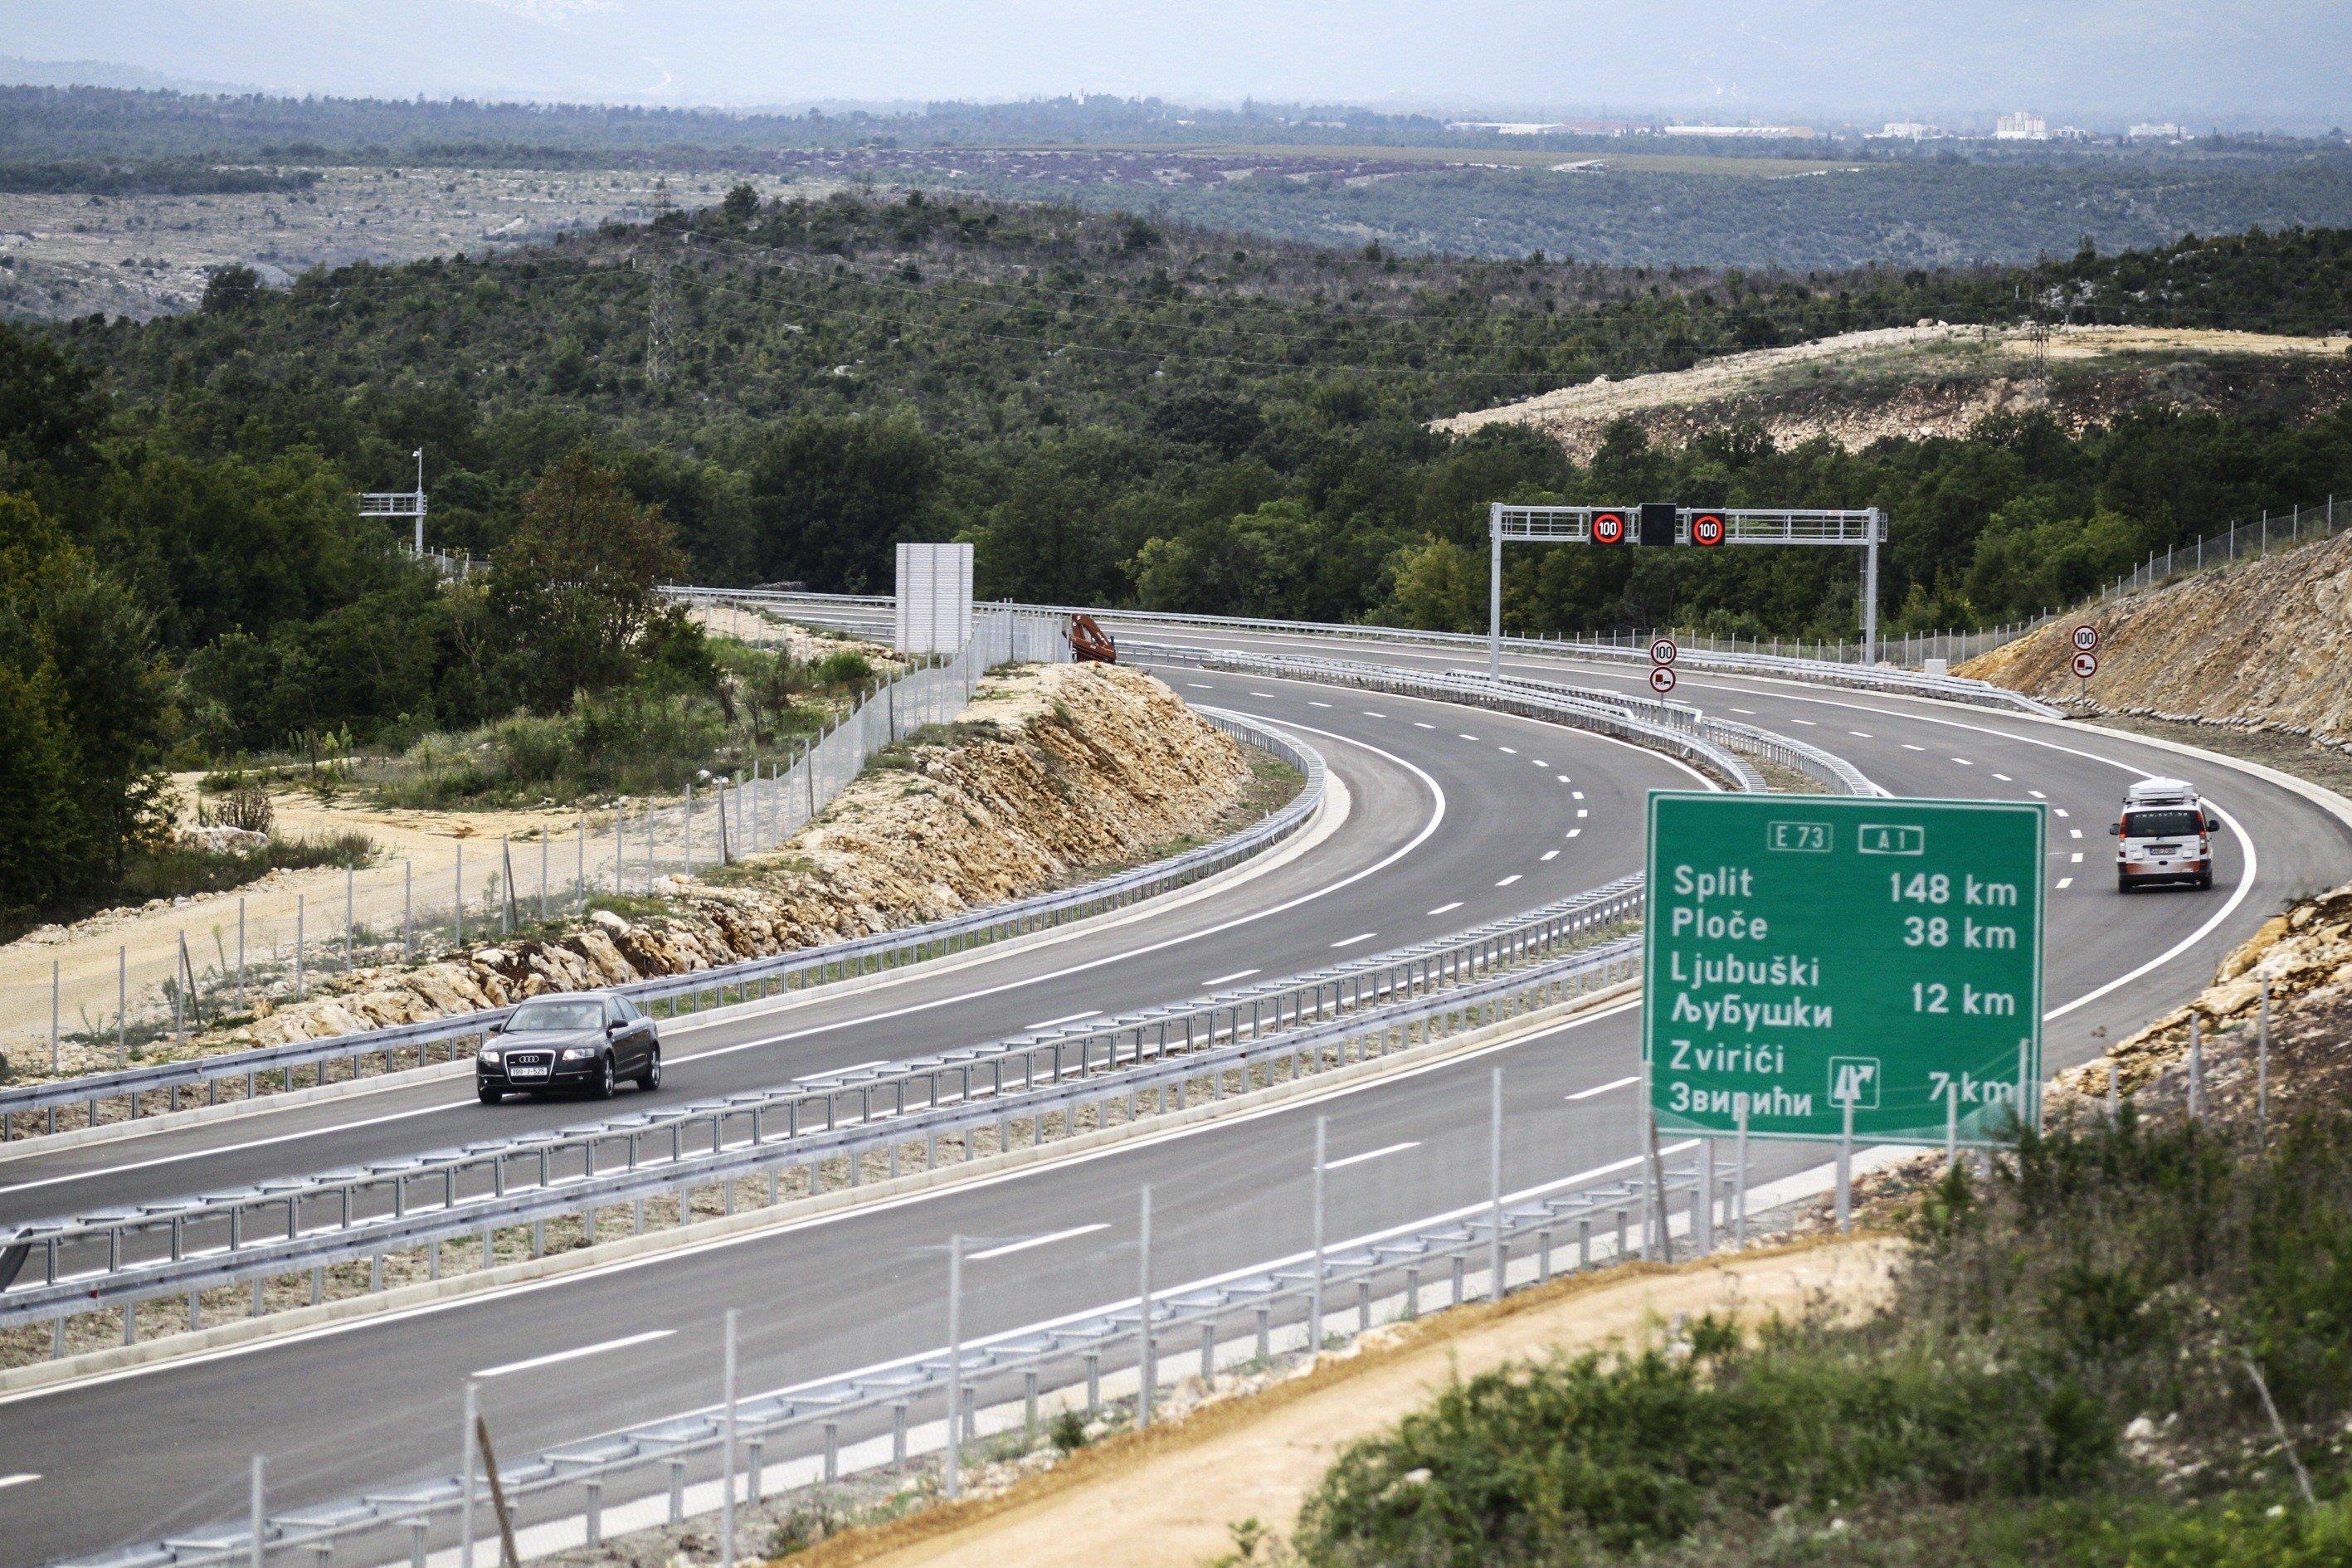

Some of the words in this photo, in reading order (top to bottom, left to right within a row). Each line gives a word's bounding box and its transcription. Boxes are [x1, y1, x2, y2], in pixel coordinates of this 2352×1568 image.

[1599, 522, 1617, 536] 100
[1698, 523, 1717, 538] 100
[1656, 646, 1673, 659] 100
[2077, 632, 2094, 645] 100
[1777, 826, 1788, 848] E
[1798, 826, 1824, 848] 73
[1877, 830, 1890, 850] A
[1898, 831, 1906, 849] 1
[1673, 864, 1754, 903] Split
[1891, 874, 1950, 904] 148
[1965, 874, 2018, 907] km
[1672, 907, 1769, 941] Ploče
[1903, 916, 1950, 947] 38
[1964, 917, 2017, 949] km
[1671, 951, 1819, 990] Ljubuški
[1671, 992, 1833, 1032] Љубушки
[1912, 982, 1950, 1014] 12
[1962, 983, 2015, 1016] km
[1670, 1039, 1785, 1074] Zvirići
[1669, 1081, 1813, 1121] Звирићи
[1928, 1071, 1950, 1103] 7
[1960, 1071, 2014, 1104] km
